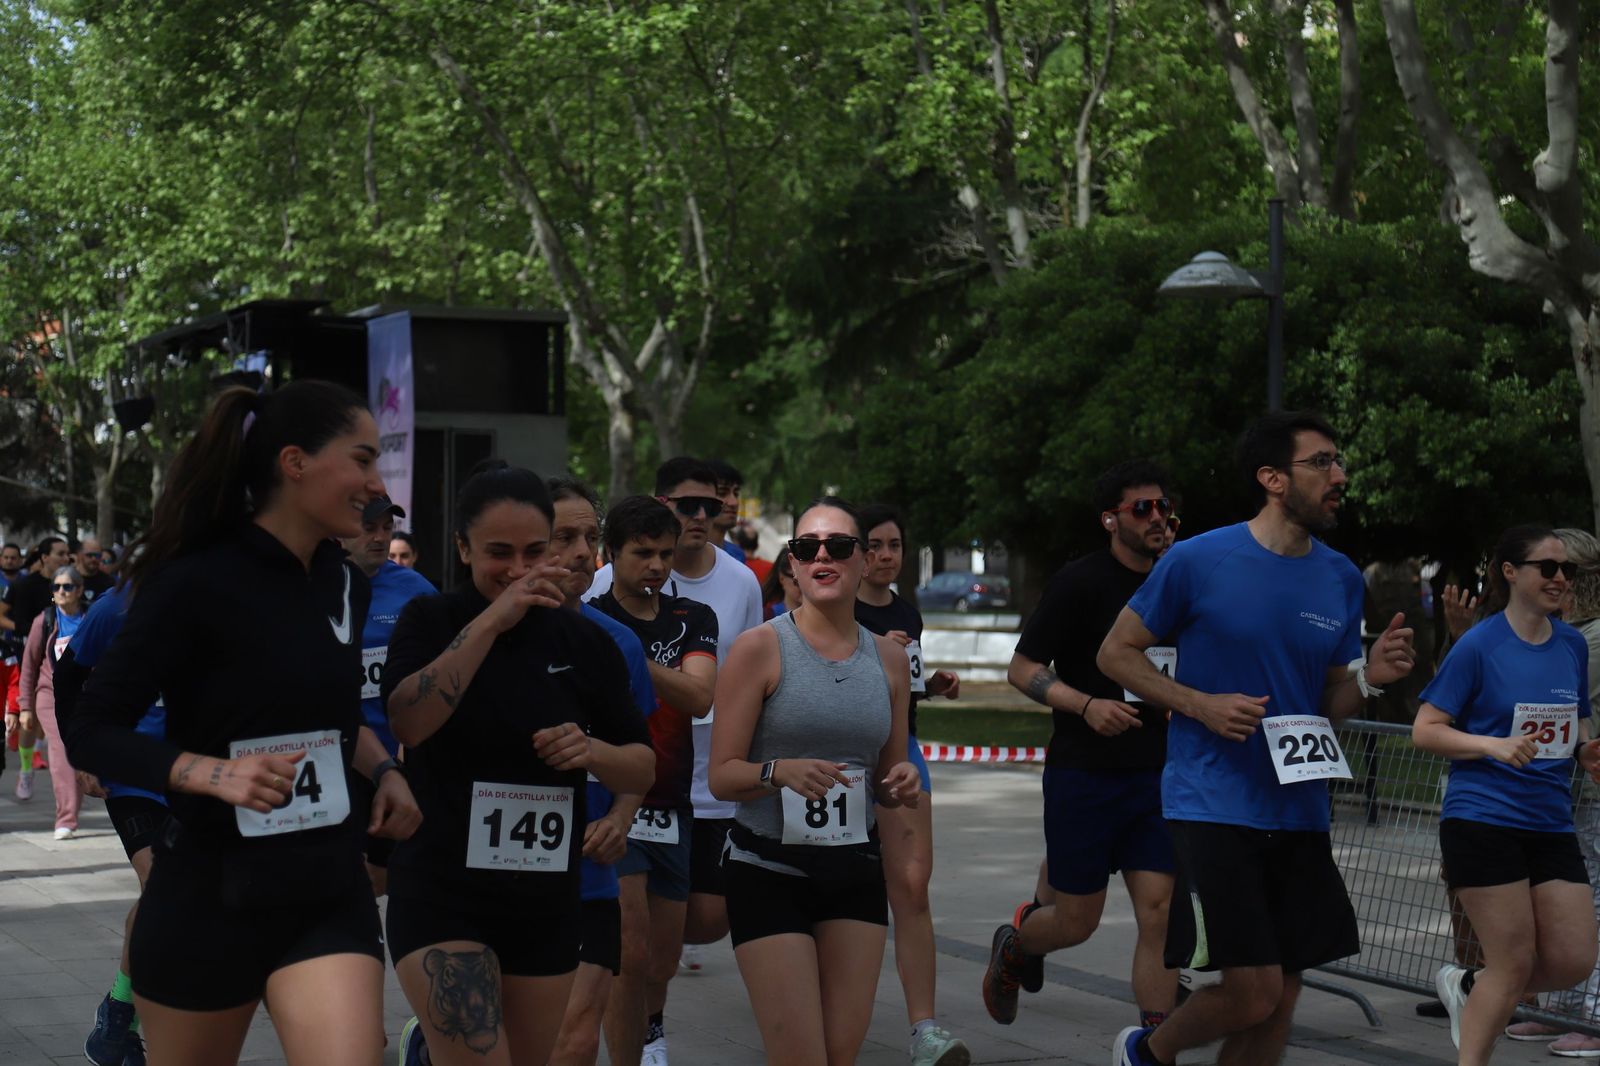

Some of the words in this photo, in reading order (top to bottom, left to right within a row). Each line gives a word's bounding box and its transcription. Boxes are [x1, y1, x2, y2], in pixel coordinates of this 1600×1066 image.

[1521, 721, 1571, 745] 251
[236, 747, 253, 758] DÍA
[268, 742, 306, 753] CASTILLA
[1279, 733, 1340, 767] 220
[478, 788, 494, 798] DÍA
[495, 791, 507, 799] DE
[508, 792, 545, 801] CASTILLA
[552, 794, 569, 802] LEÓN
[805, 792, 847, 829] 81
[483, 808, 565, 851] 149
